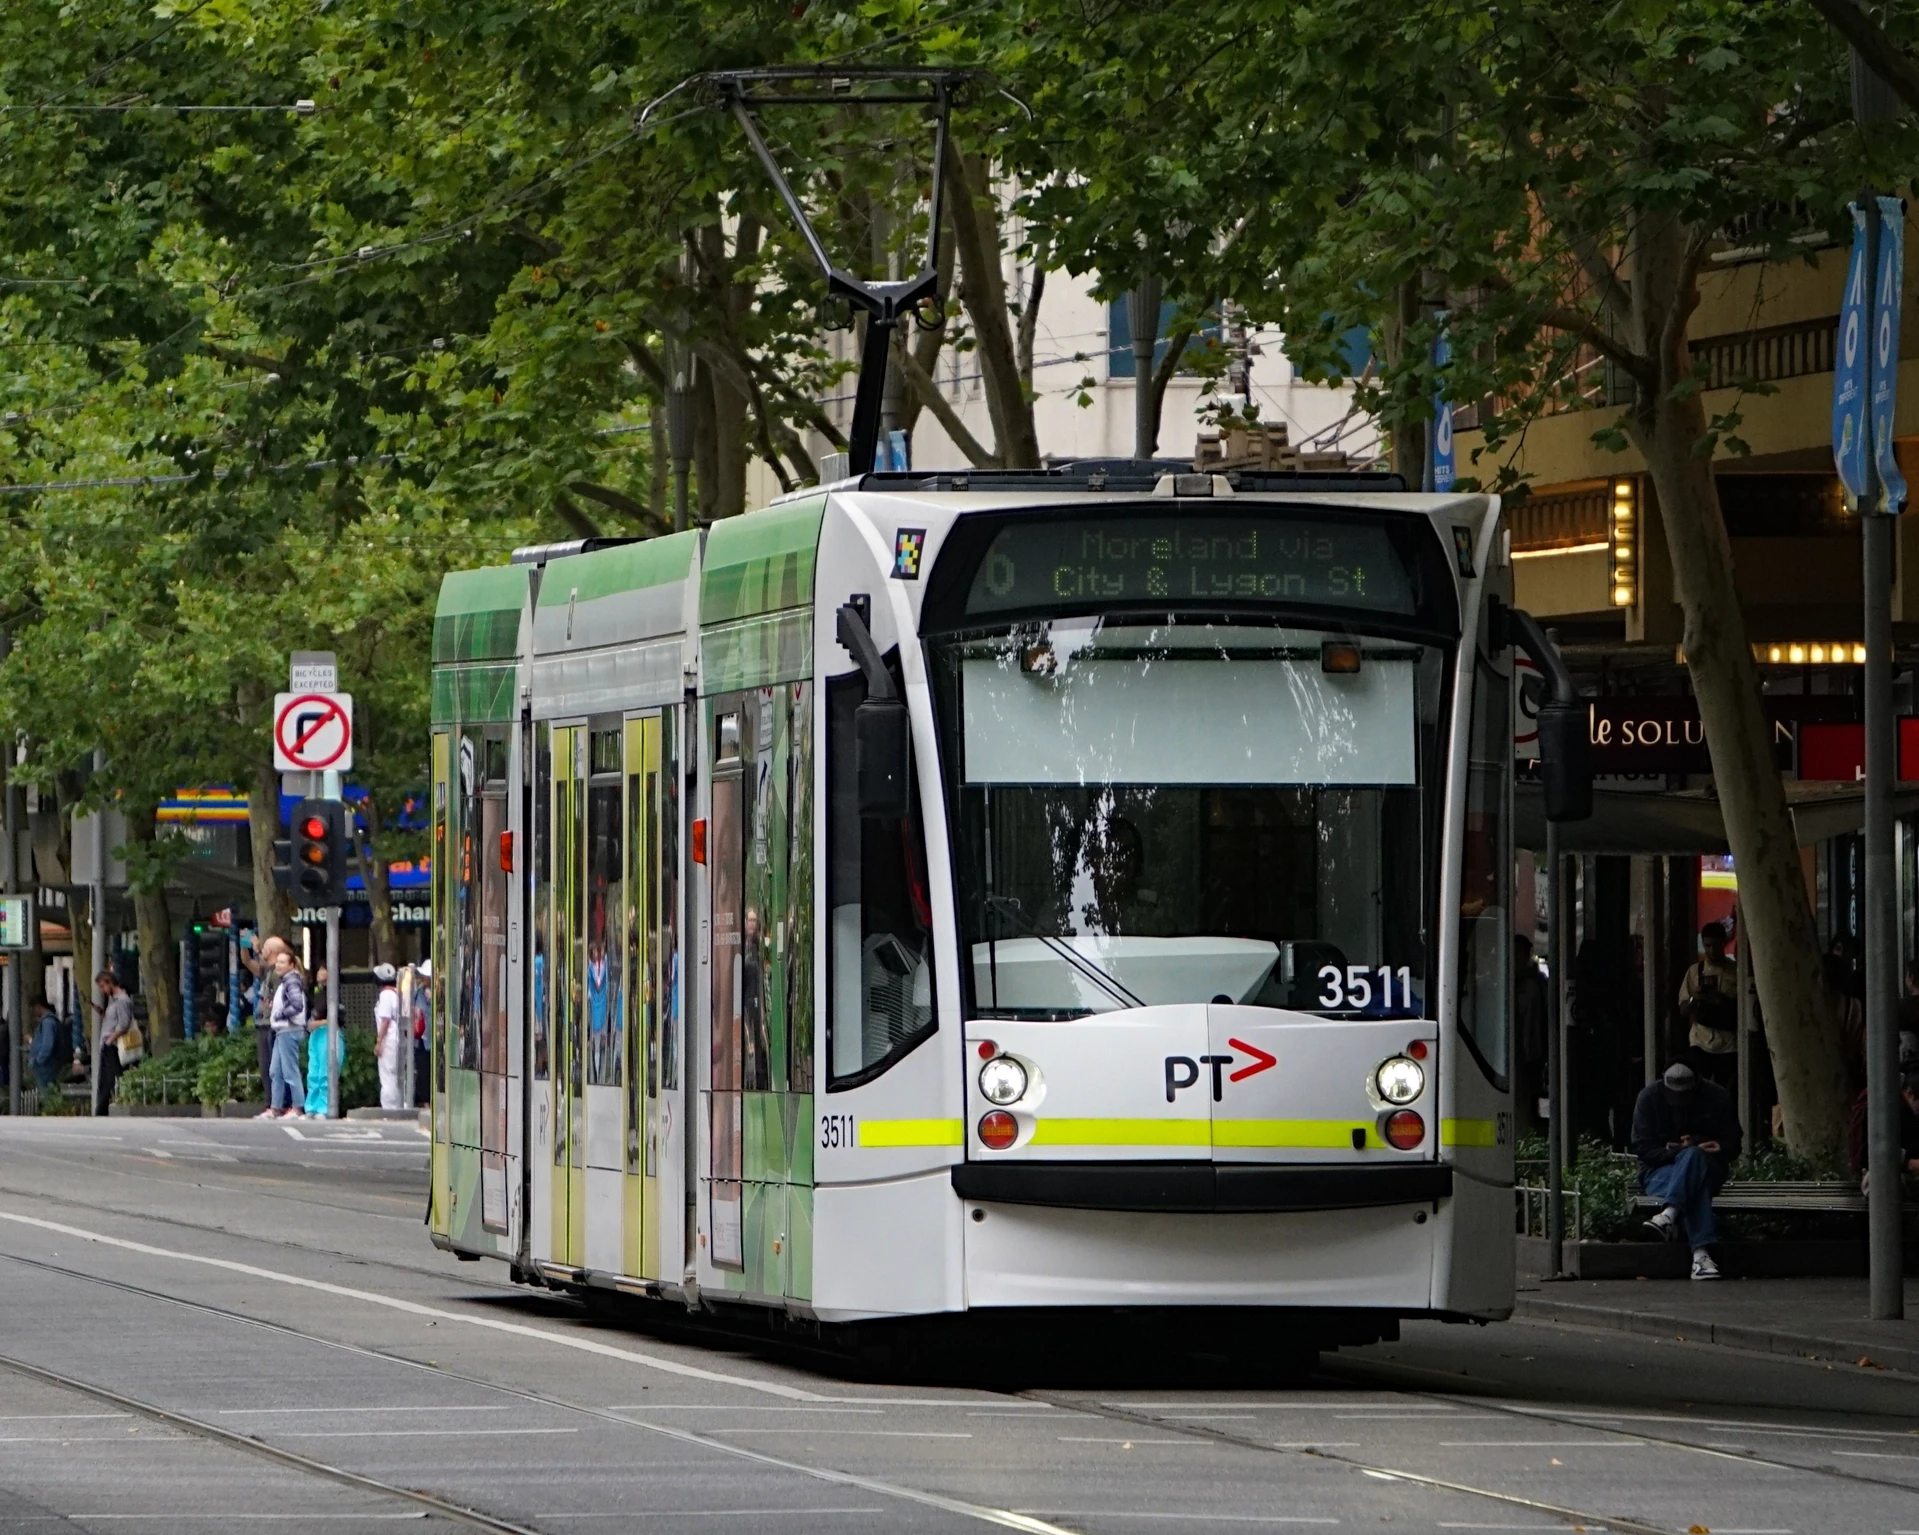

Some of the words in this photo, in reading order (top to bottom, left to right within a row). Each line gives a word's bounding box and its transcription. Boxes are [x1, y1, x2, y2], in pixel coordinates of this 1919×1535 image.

[1082, 530, 1256, 559] Moreland
[1279, 531, 1332, 559] via
[1054, 566, 1124, 596] City
[1147, 567, 1168, 596] &
[1191, 566, 1305, 596] Lygon
[1329, 566, 1366, 596] St
[1590, 703, 1612, 745] le
[1622, 720, 1794, 745] SOLUN
[1318, 965, 1411, 1008] 3511
[821, 1114, 854, 1148] 3511
